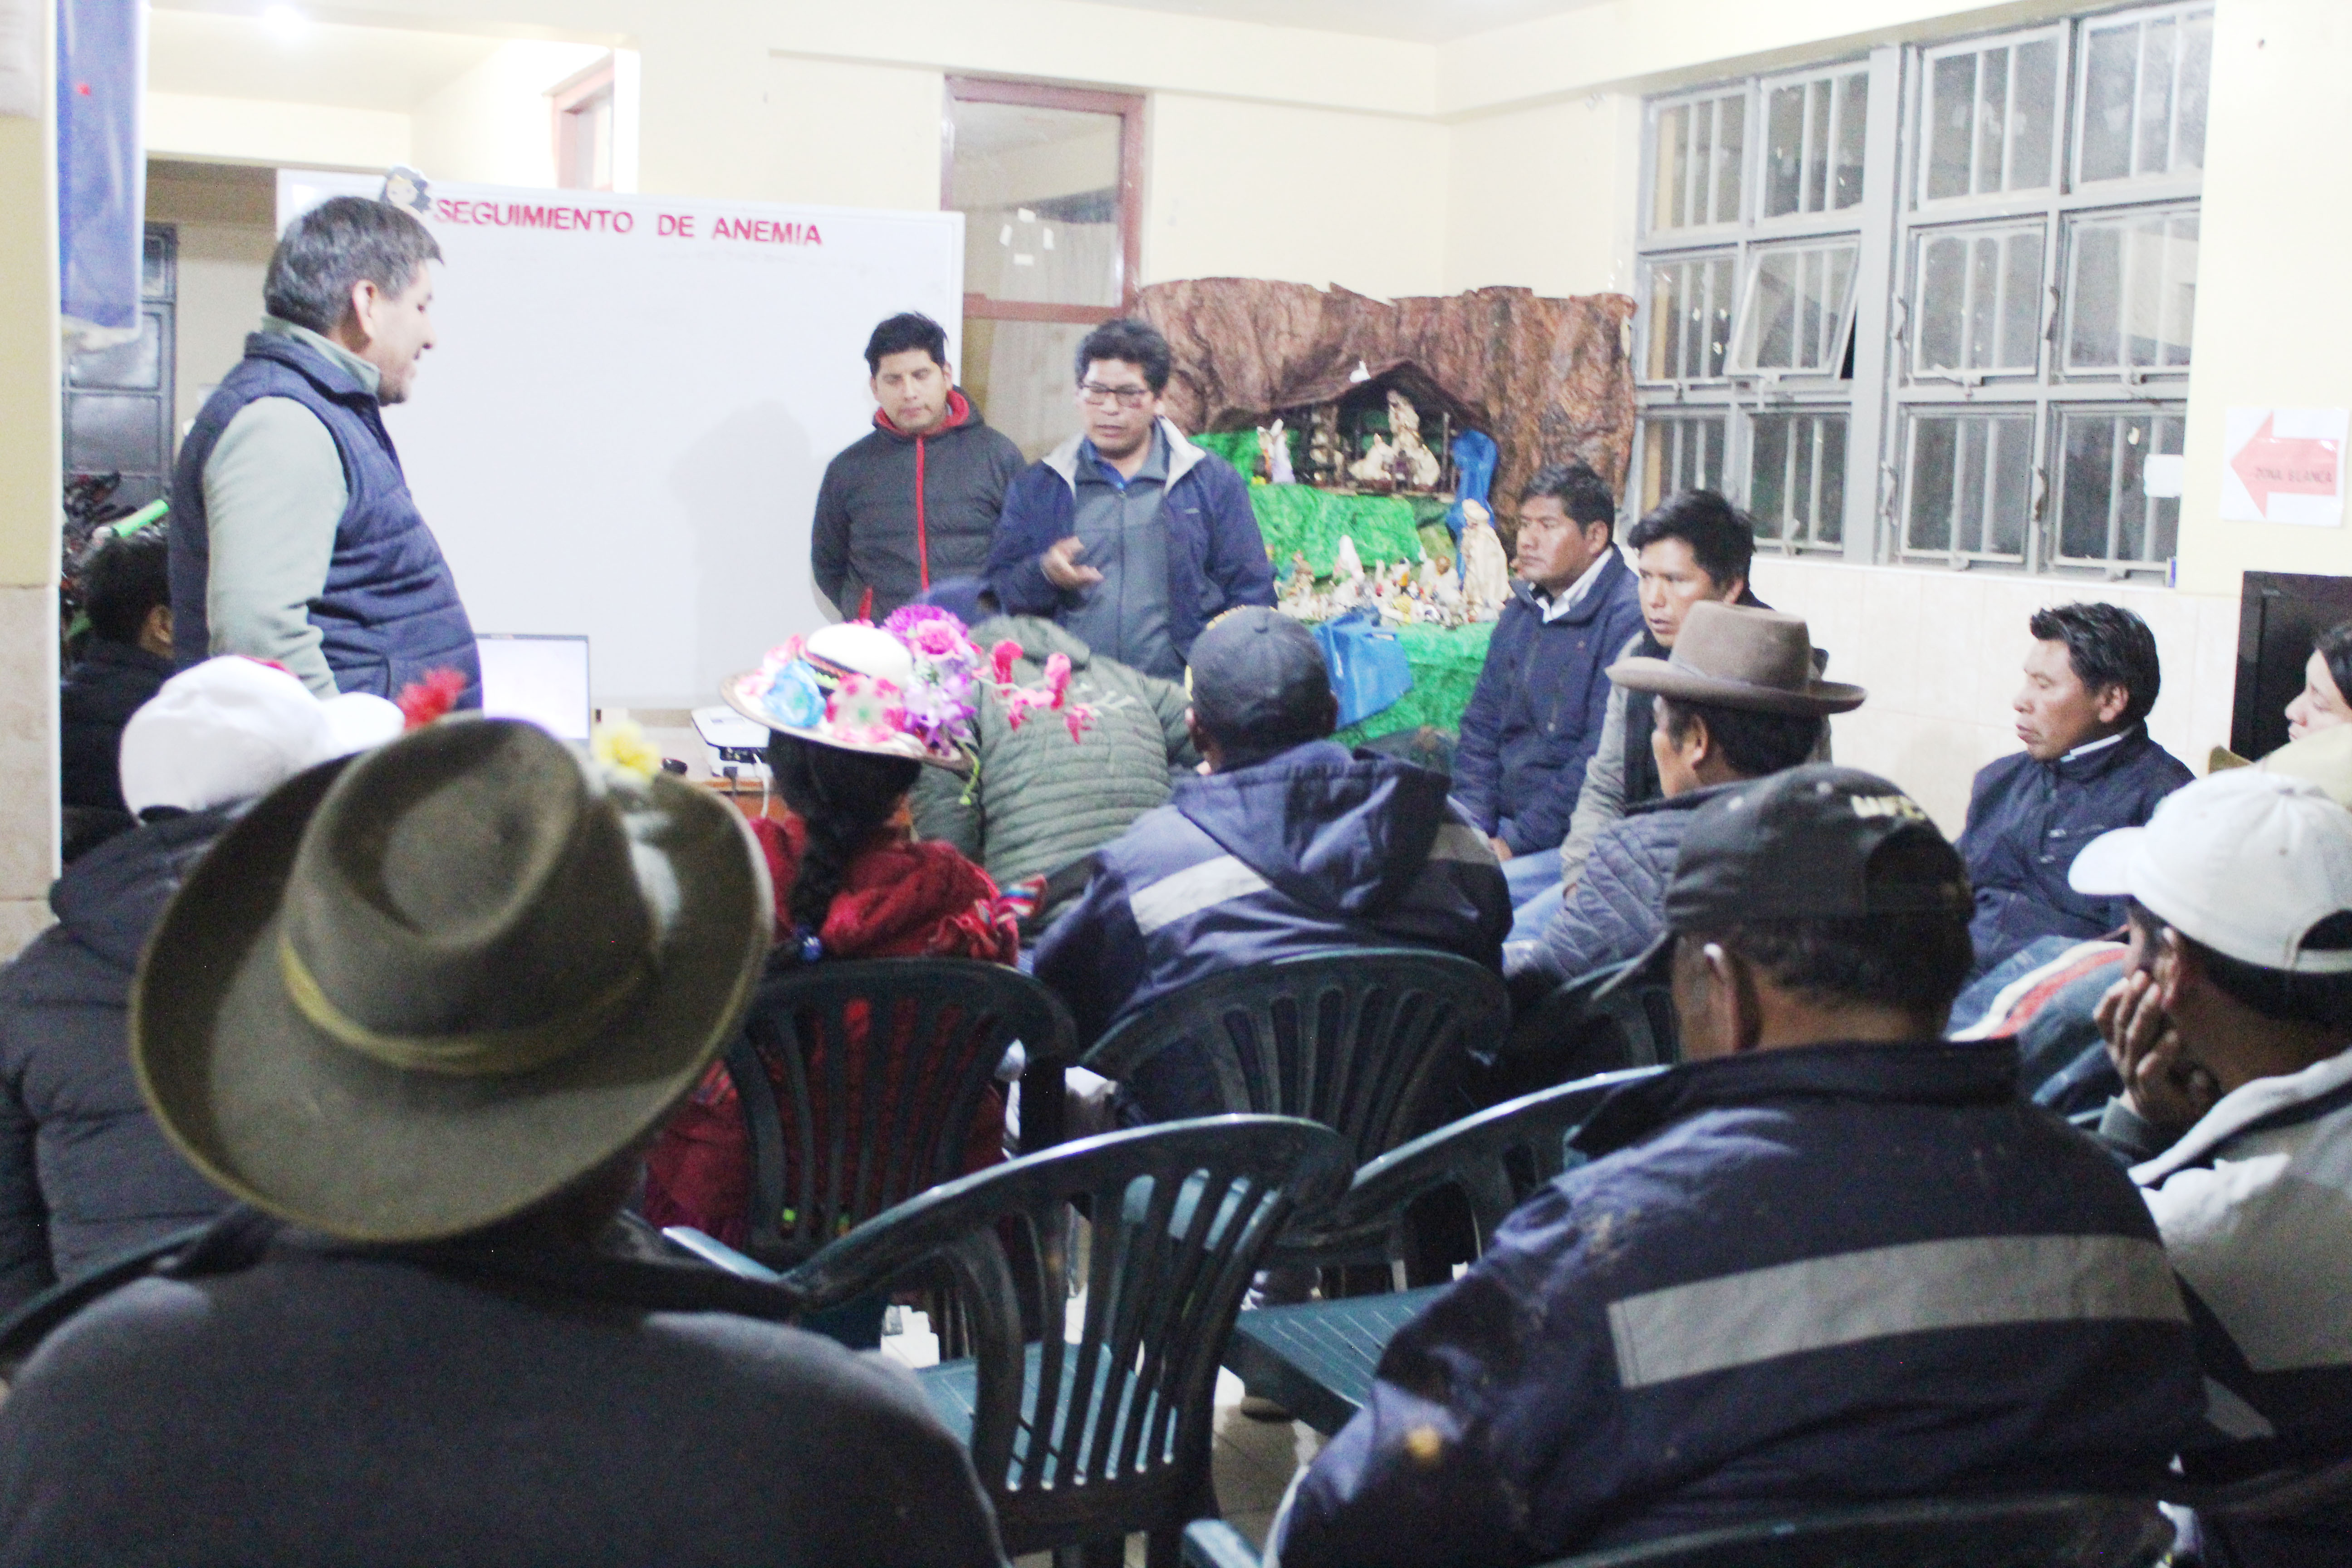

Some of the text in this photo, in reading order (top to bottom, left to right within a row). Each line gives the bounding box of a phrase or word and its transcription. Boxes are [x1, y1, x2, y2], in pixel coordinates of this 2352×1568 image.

[434, 199, 822, 245] SEGUIMIENTO DE ANEMIA
